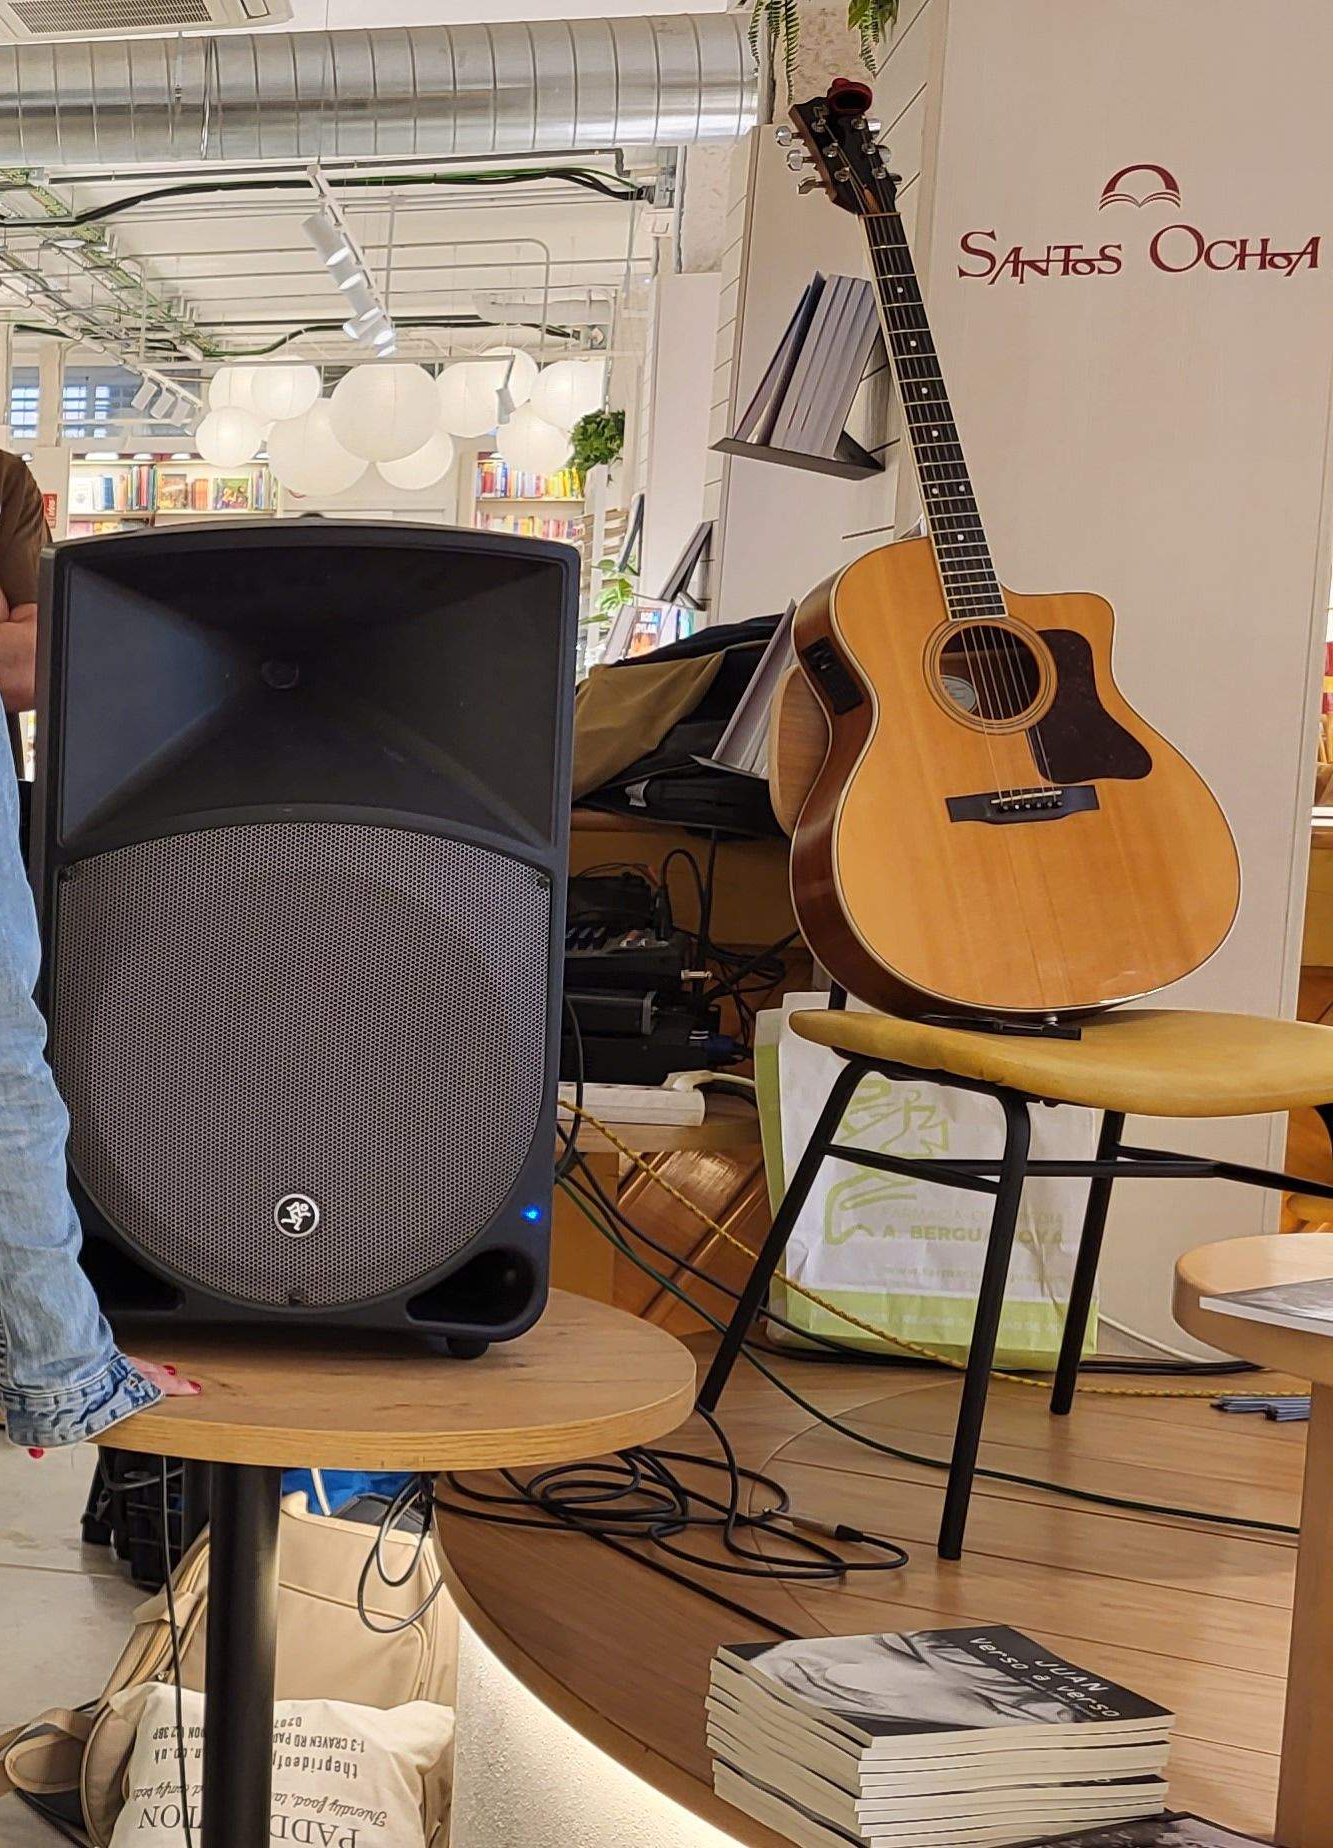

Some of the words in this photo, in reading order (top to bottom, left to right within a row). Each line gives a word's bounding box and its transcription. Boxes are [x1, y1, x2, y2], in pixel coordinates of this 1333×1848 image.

[910, 1225, 981, 1242] BERGU
[1032, 1673, 1052, 1682] a
[1034, 1659, 1110, 1692] JUAN
[294, 1733, 307, 1748] RD
[310, 1734, 348, 1751] CRAVEN
[327, 1797, 388, 1828] Friendly
